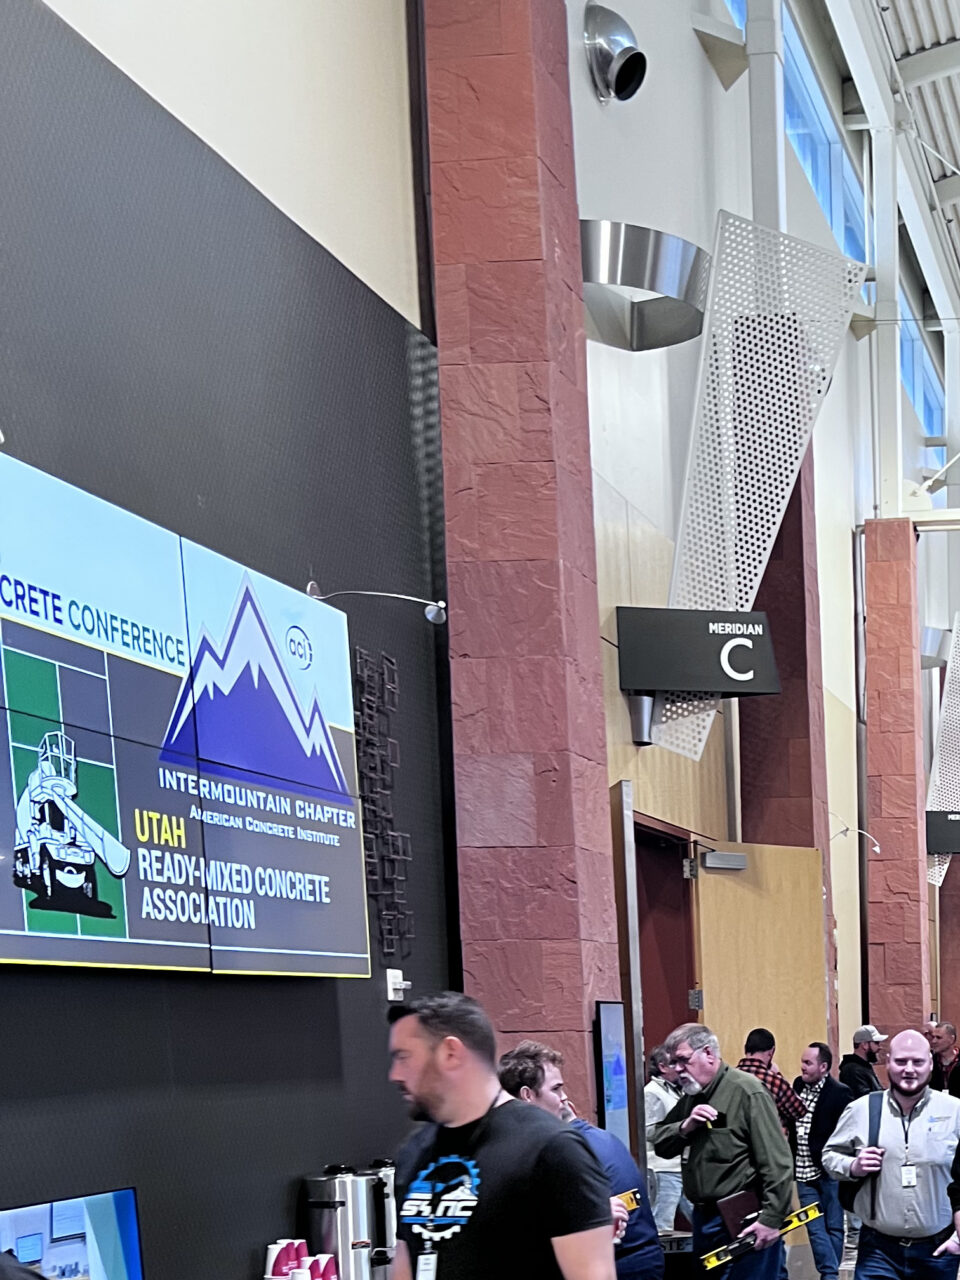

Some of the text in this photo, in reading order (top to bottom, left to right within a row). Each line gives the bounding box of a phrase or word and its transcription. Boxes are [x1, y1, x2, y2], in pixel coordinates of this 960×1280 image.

[0, 574, 186, 667] CRETE CONFERENCE
[708, 622, 763, 635] MERIDIAN
[720, 637, 754, 681] C
[158, 767, 356, 829] INTERMOUNTAIN CHAPTER
[134, 808, 187, 849] UTAH
[189, 804, 341, 847] AMERICAN CONCRETE INSTITUTE
[137, 847, 331, 904] READY-MIXED CONCRETE
[141, 886, 256, 930] ASSOCIATION
